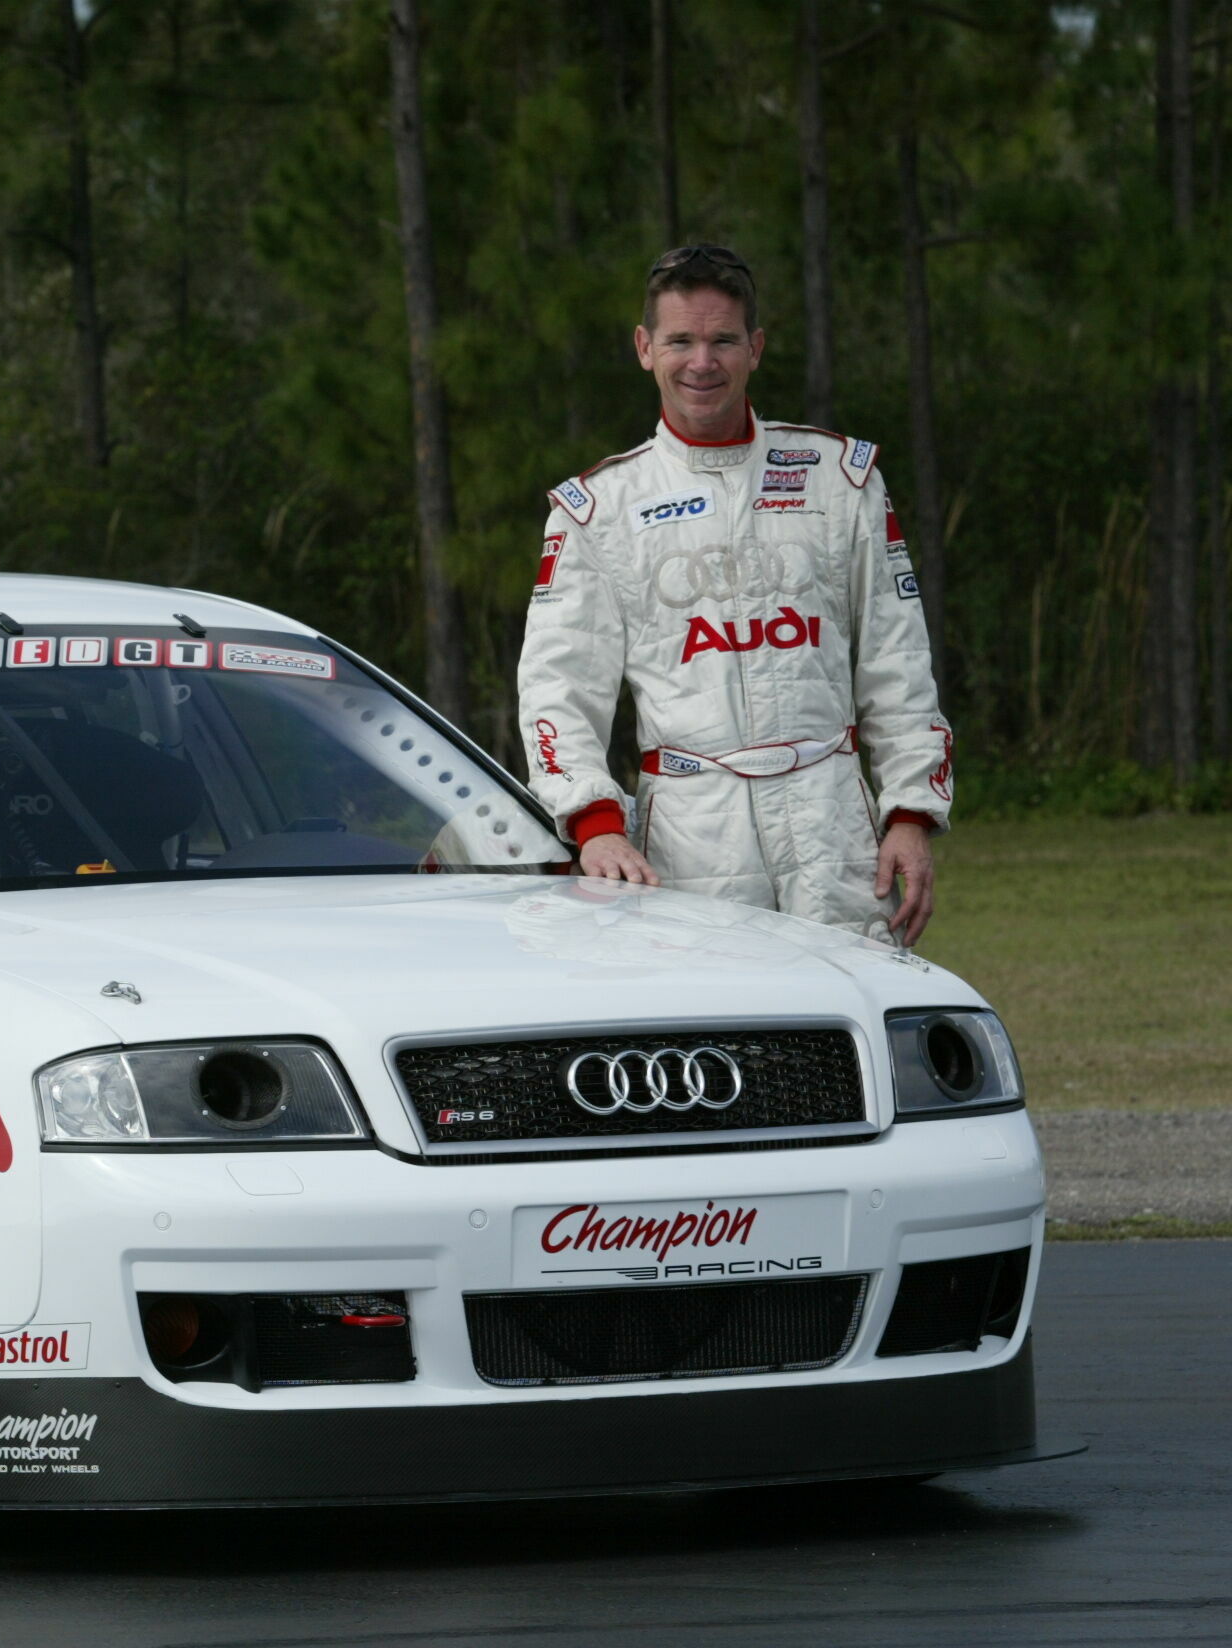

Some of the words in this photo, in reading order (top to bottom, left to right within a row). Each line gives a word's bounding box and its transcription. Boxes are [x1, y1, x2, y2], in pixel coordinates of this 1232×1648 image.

[852, 440, 870, 467] spar
[639, 496, 706, 525] TOYO
[680, 606, 821, 665] Audi
[123, 641, 203, 663] GT
[664, 754, 699, 770] sparco
[541, 1200, 757, 1263] Champion
[665, 1256, 822, 1279] RACING
[12, 1464, 47, 1473] ALLOY
[51, 1464, 100, 1473] WHEELS
